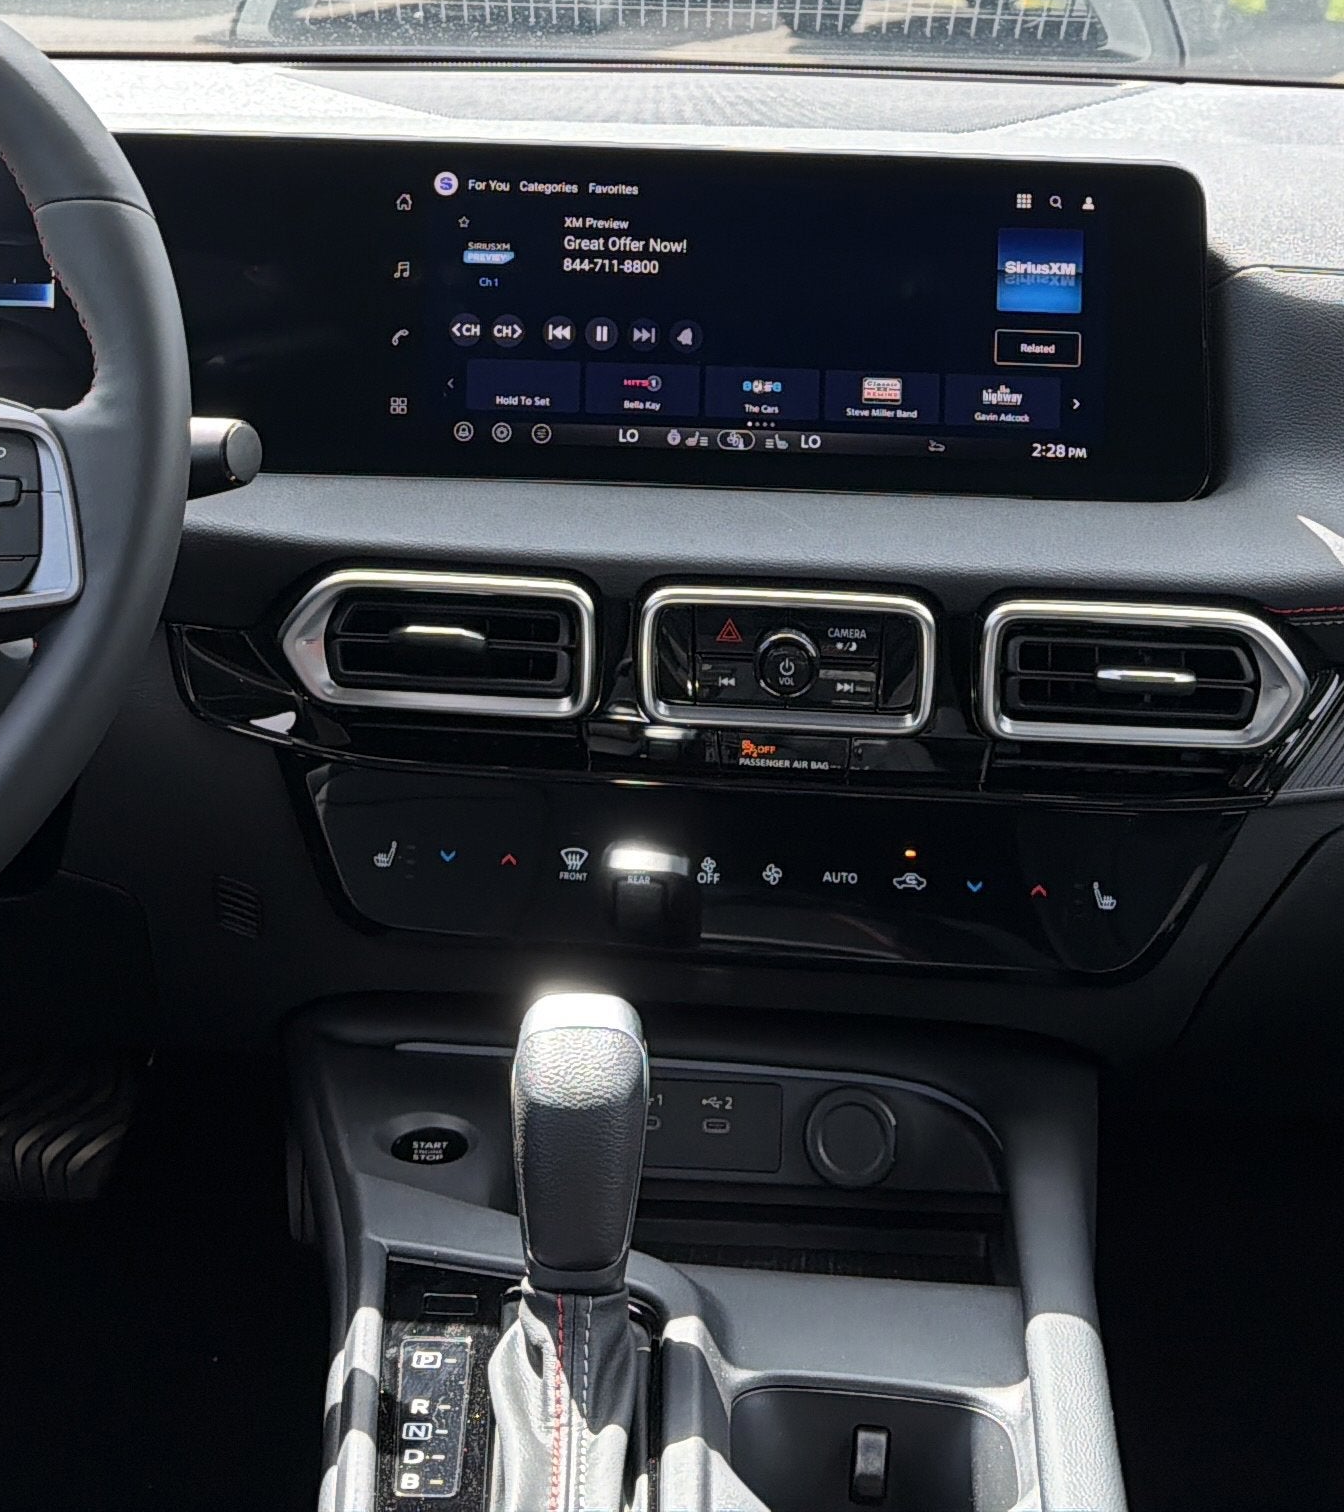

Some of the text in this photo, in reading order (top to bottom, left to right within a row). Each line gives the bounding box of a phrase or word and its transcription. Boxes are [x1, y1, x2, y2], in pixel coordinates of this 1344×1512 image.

[468, 179, 639, 195] For You Categories Favorites
[564, 217, 629, 230] XM Preview
[563, 236, 688, 253] Great Offer Now!
[563, 258, 659, 274] 844-711-8800
[1005, 261, 1076, 275] SiriusXM
[479, 277, 499, 287] Ch 1
[1020, 343, 1056, 354] Related
[495, 395, 551, 407] Hold To Set
[983, 389, 1023, 405] highway
[623, 400, 661, 411] Bella Kay
[745, 404, 779, 414] The Cars
[846, 408, 918, 418] Steve Miller Band
[974, 412, 1030, 423] Gavin Adcock
[618, 428, 639, 443] LO
[800, 434, 822, 449] LO
[1031, 443, 1087, 459] 2:28 PM
[828, 627, 867, 639] CAMERA
[779, 677, 795, 687] VOL
[758, 745, 776, 754] OFF
[739, 757, 829, 770] PASSENGER AIR BAG
[559, 871, 587, 882] FRONT
[627, 874, 651, 885] REAR
[696, 872, 720, 885] OFF
[823, 871, 858, 884] AUTO
[657, 1094, 663, 1106] 1
[725, 1096, 733, 1109] 2
[412, 1141, 448, 1149] START
[410, 1398, 430, 1414] R
[403, 1449, 425, 1464] D
[400, 1473, 420, 1490] B
